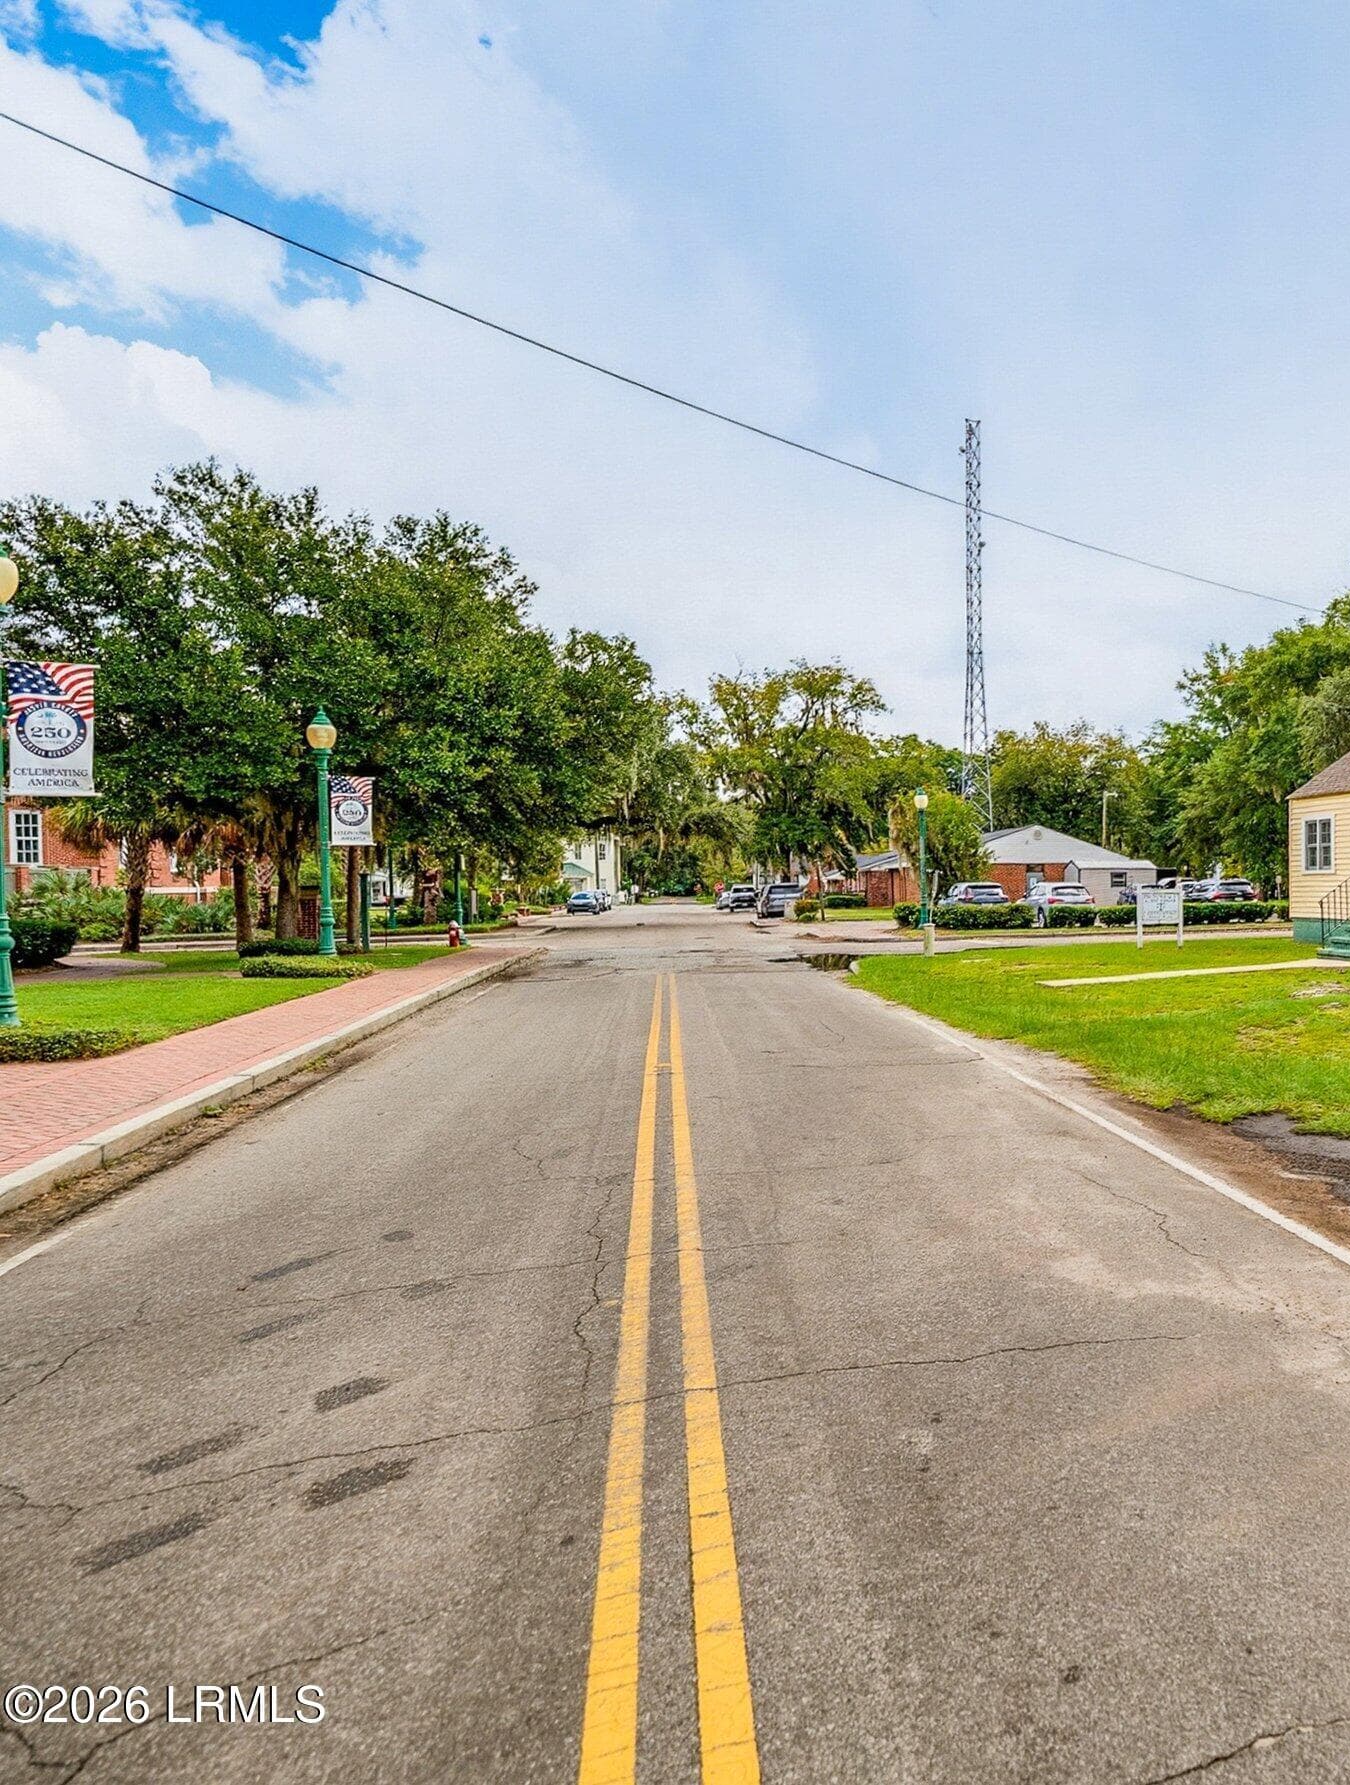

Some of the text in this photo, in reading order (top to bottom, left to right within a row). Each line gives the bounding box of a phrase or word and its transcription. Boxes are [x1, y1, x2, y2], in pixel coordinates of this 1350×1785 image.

[30, 726, 71, 738] 250
[13, 767, 88, 777] CELEBRATING
[27, 778, 80, 787] AMERICA
